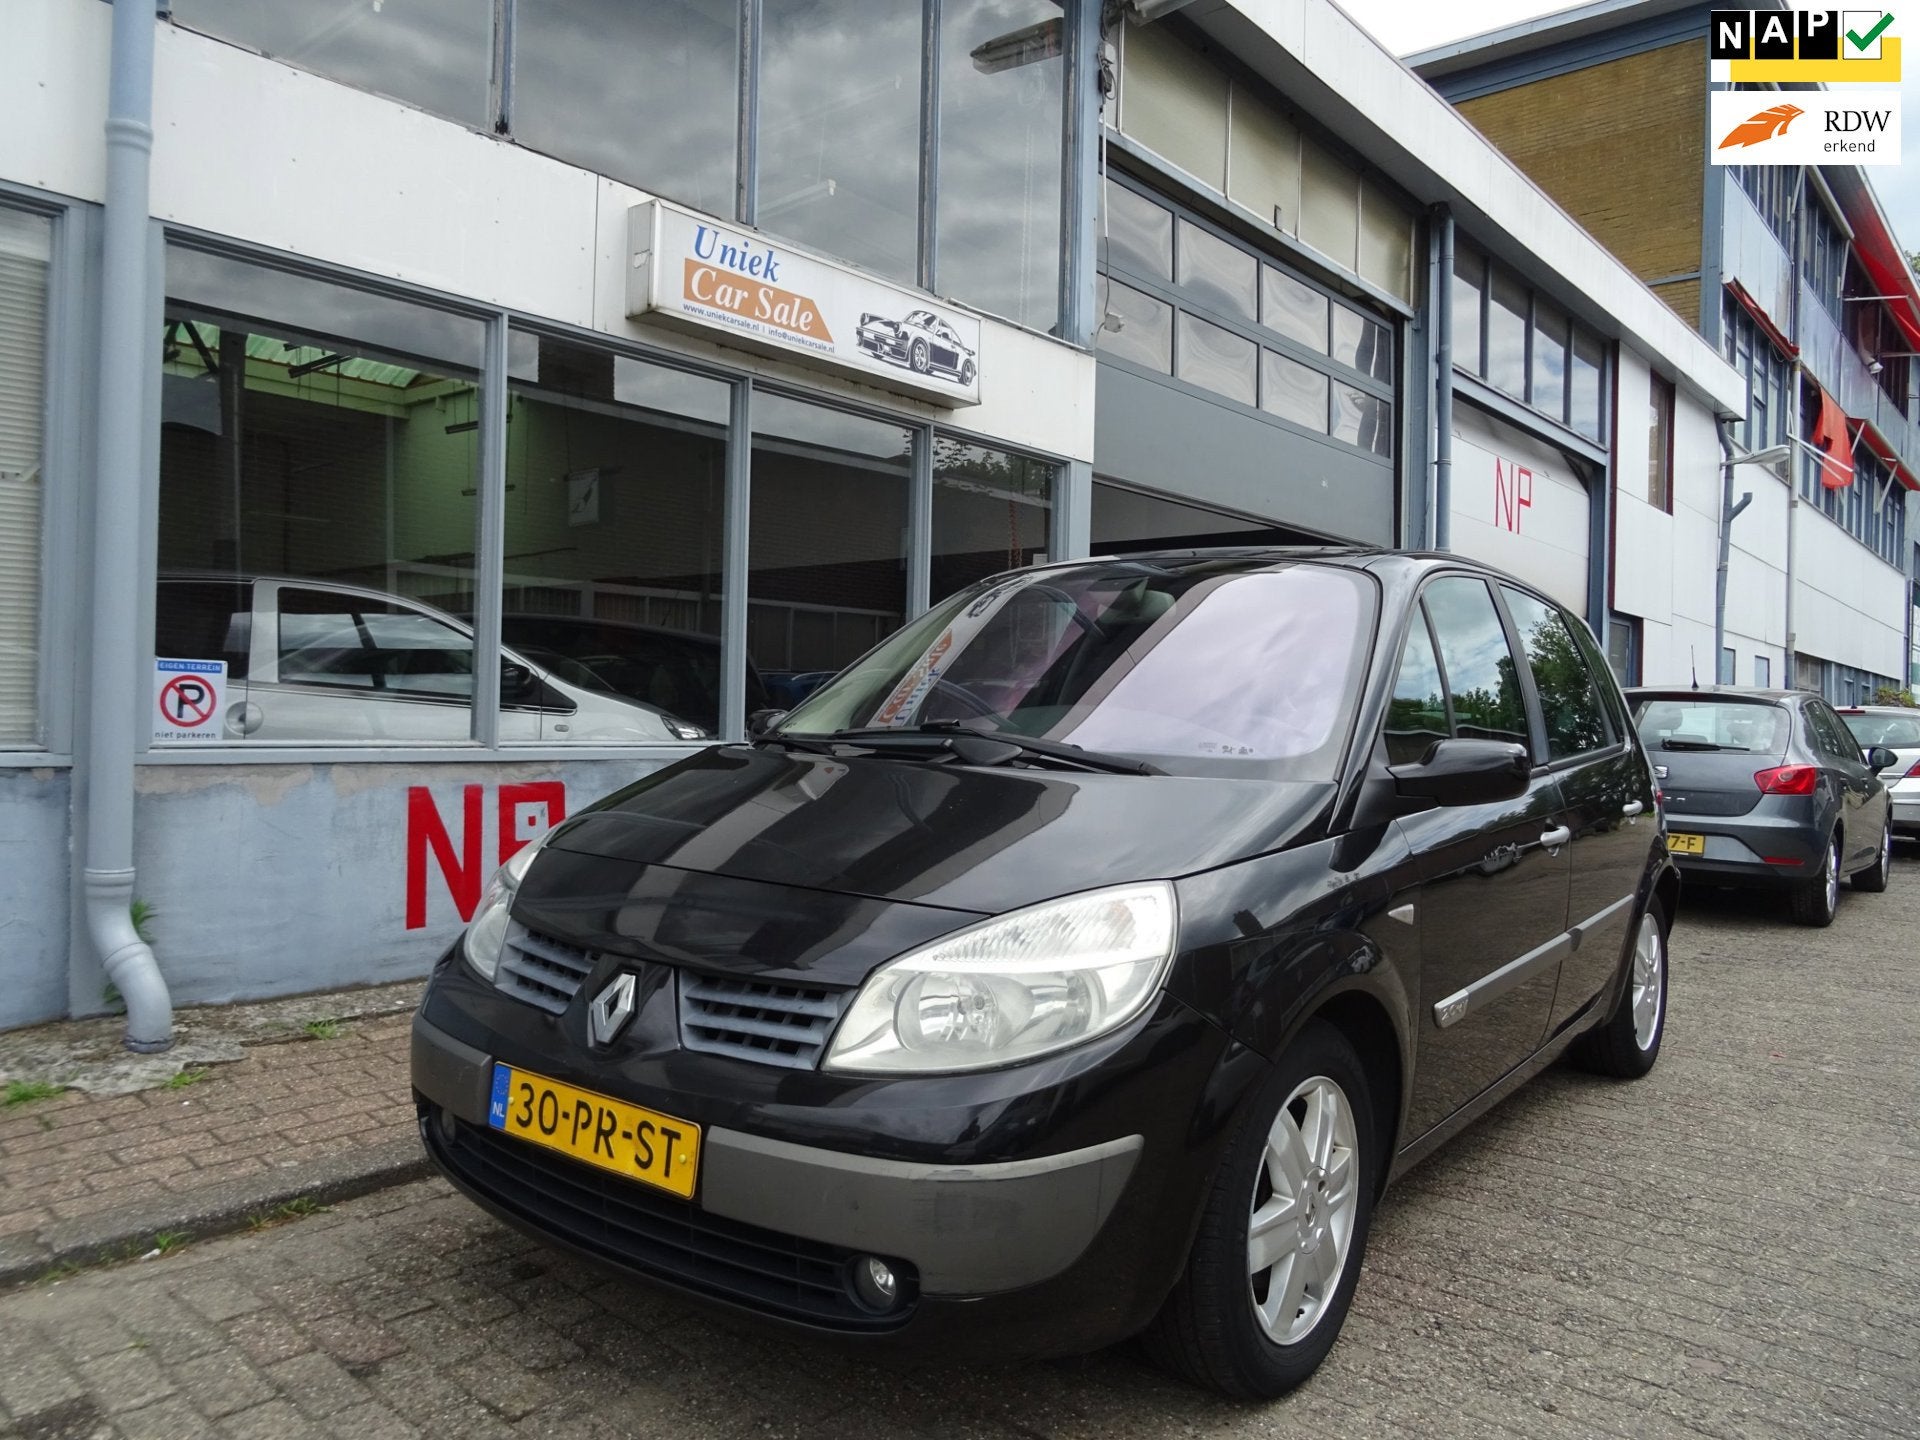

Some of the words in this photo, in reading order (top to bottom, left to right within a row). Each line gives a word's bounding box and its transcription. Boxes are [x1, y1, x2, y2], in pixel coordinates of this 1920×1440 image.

[694, 224, 780, 282] Uniek
[690, 267, 748, 310] Car
[755, 287, 813, 332] Sale
[683, 303, 760, 331] www.uniekcarsale.nl
[768, 329, 835, 354] info@uniekcarsale.nl
[1495, 457, 1532, 534] NP
[160, 662, 184, 670] EIGEN
[187, 663, 221, 671] TERREIN
[176, 731, 216, 739] parkeren
[492, 1102, 505, 1118] NL
[516, 1083, 681, 1178] 30-PR-ST
